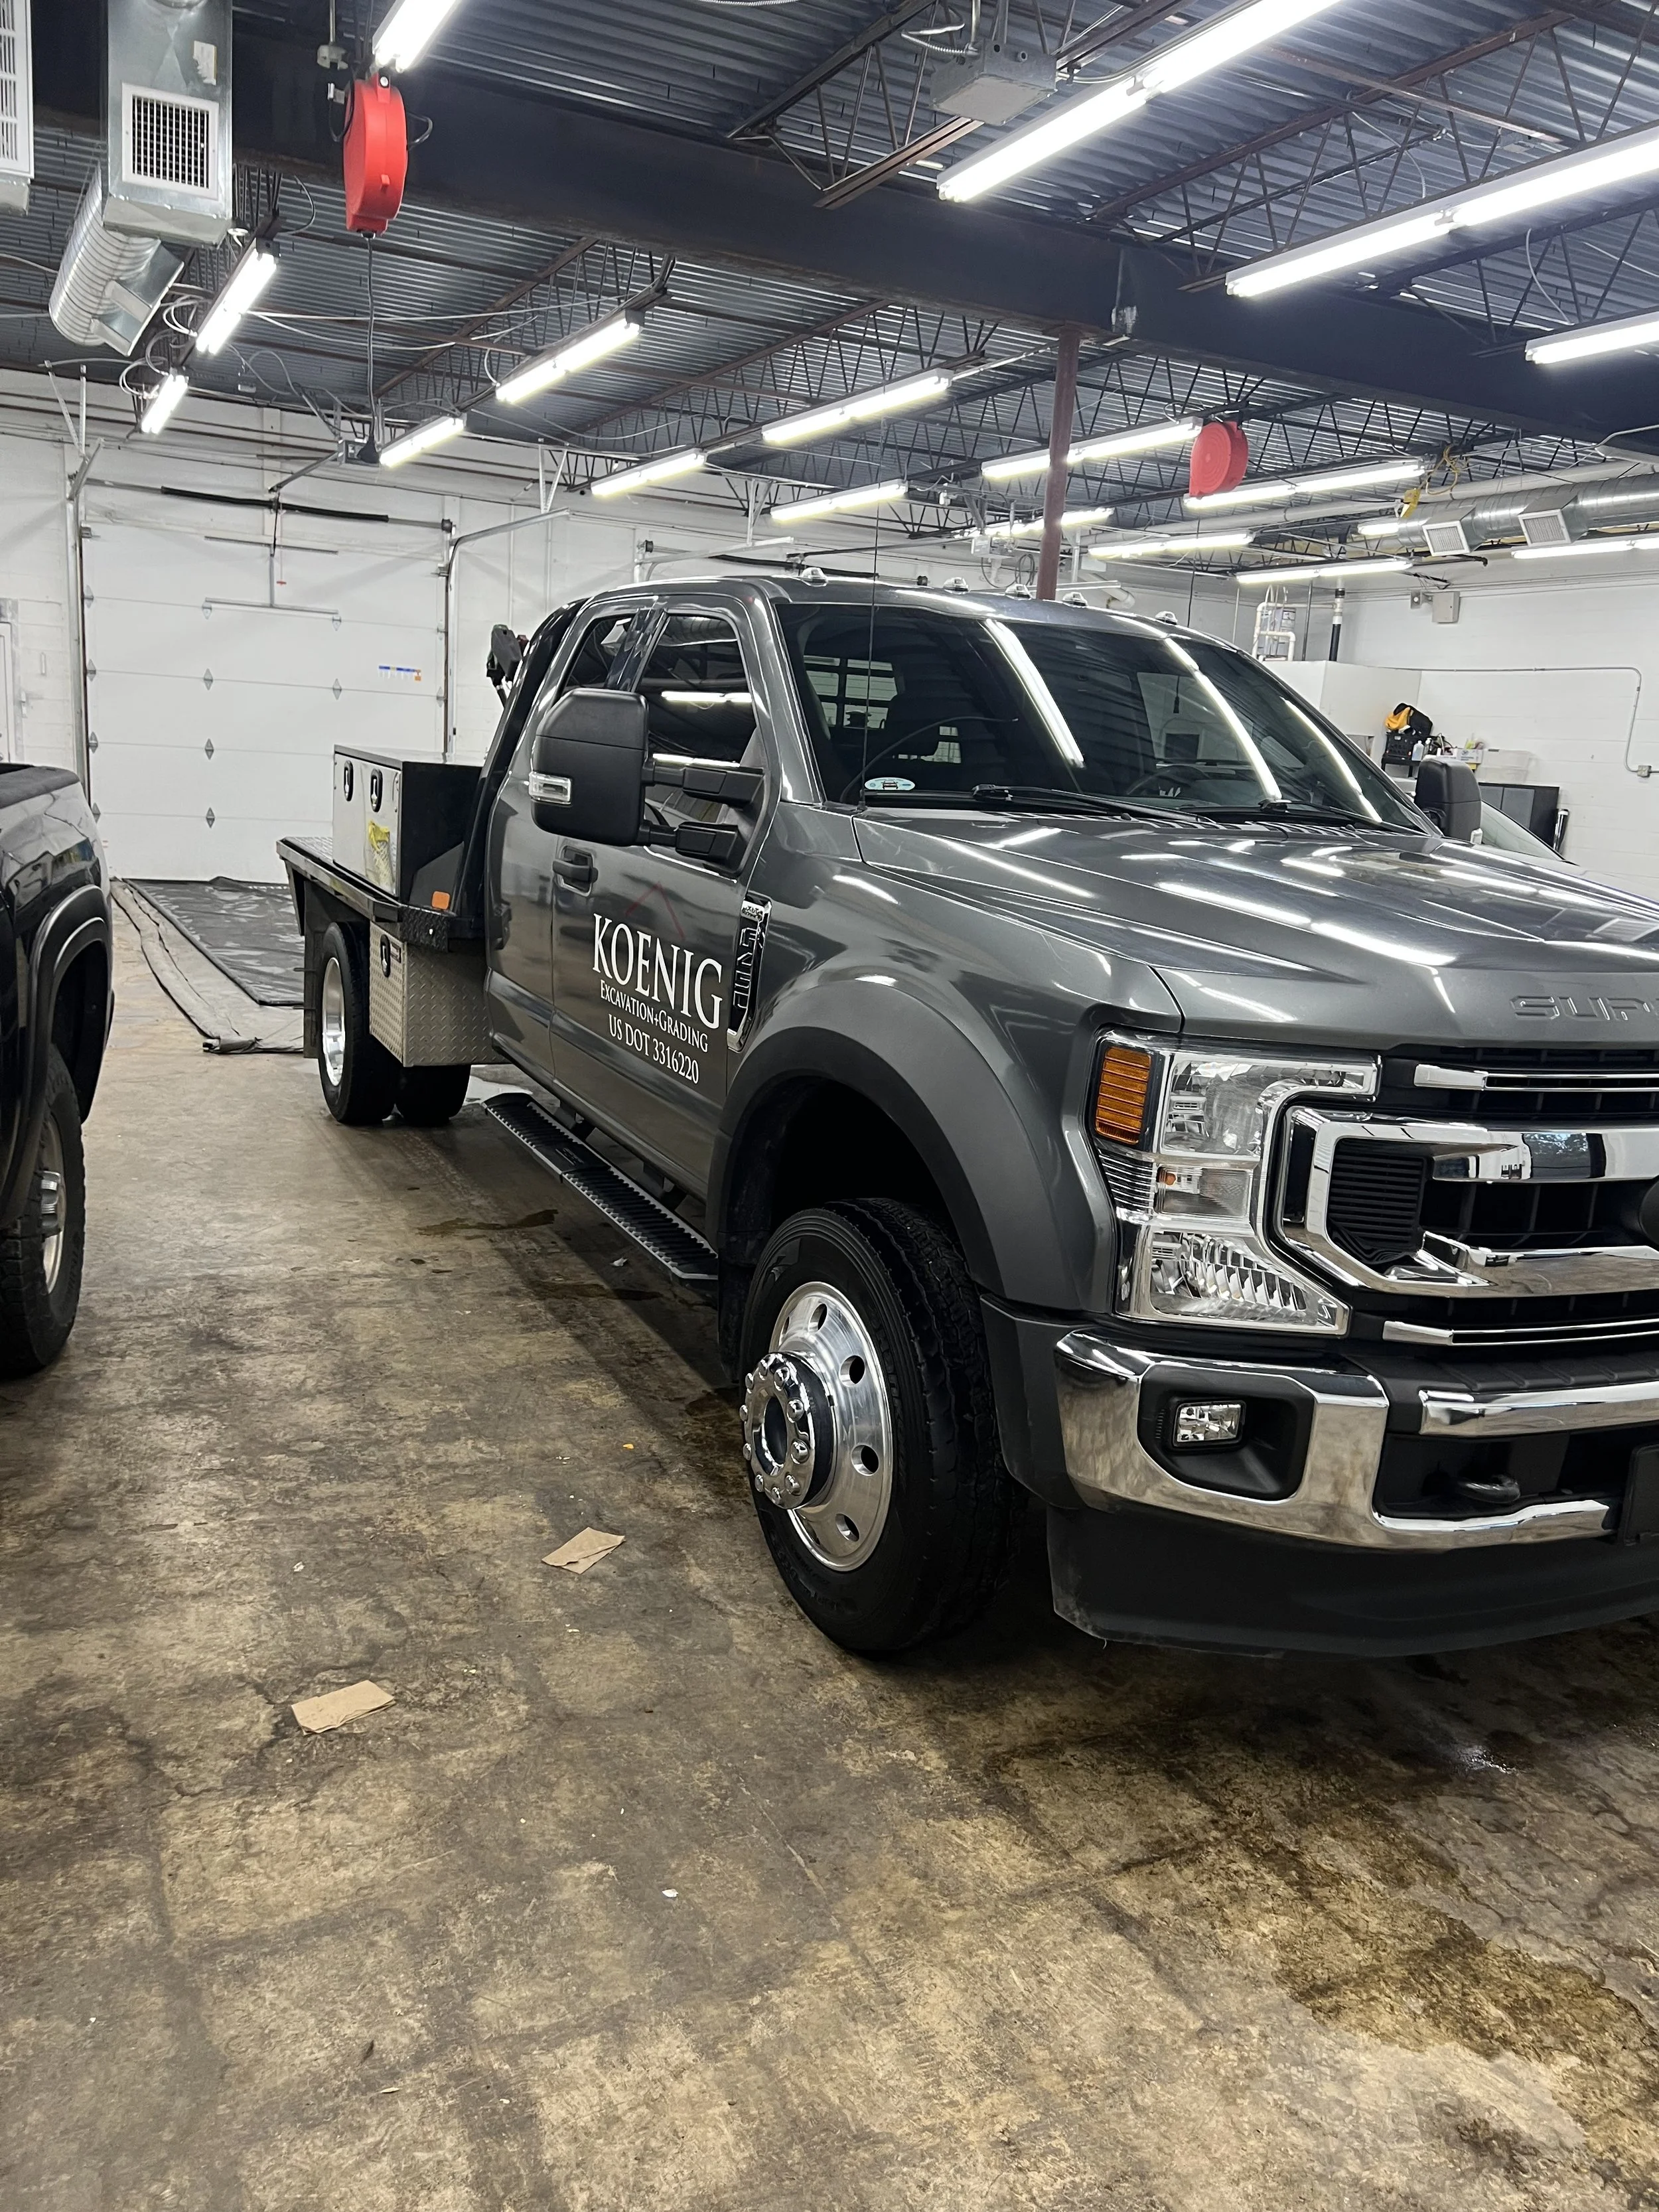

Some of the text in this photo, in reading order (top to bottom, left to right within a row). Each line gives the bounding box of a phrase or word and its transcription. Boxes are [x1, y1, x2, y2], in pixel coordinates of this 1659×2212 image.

[593, 913, 723, 1029] KOENIG
[1509, 995, 1659, 1021] SUP
[609, 1013, 699, 1084] US DOT 3316220
